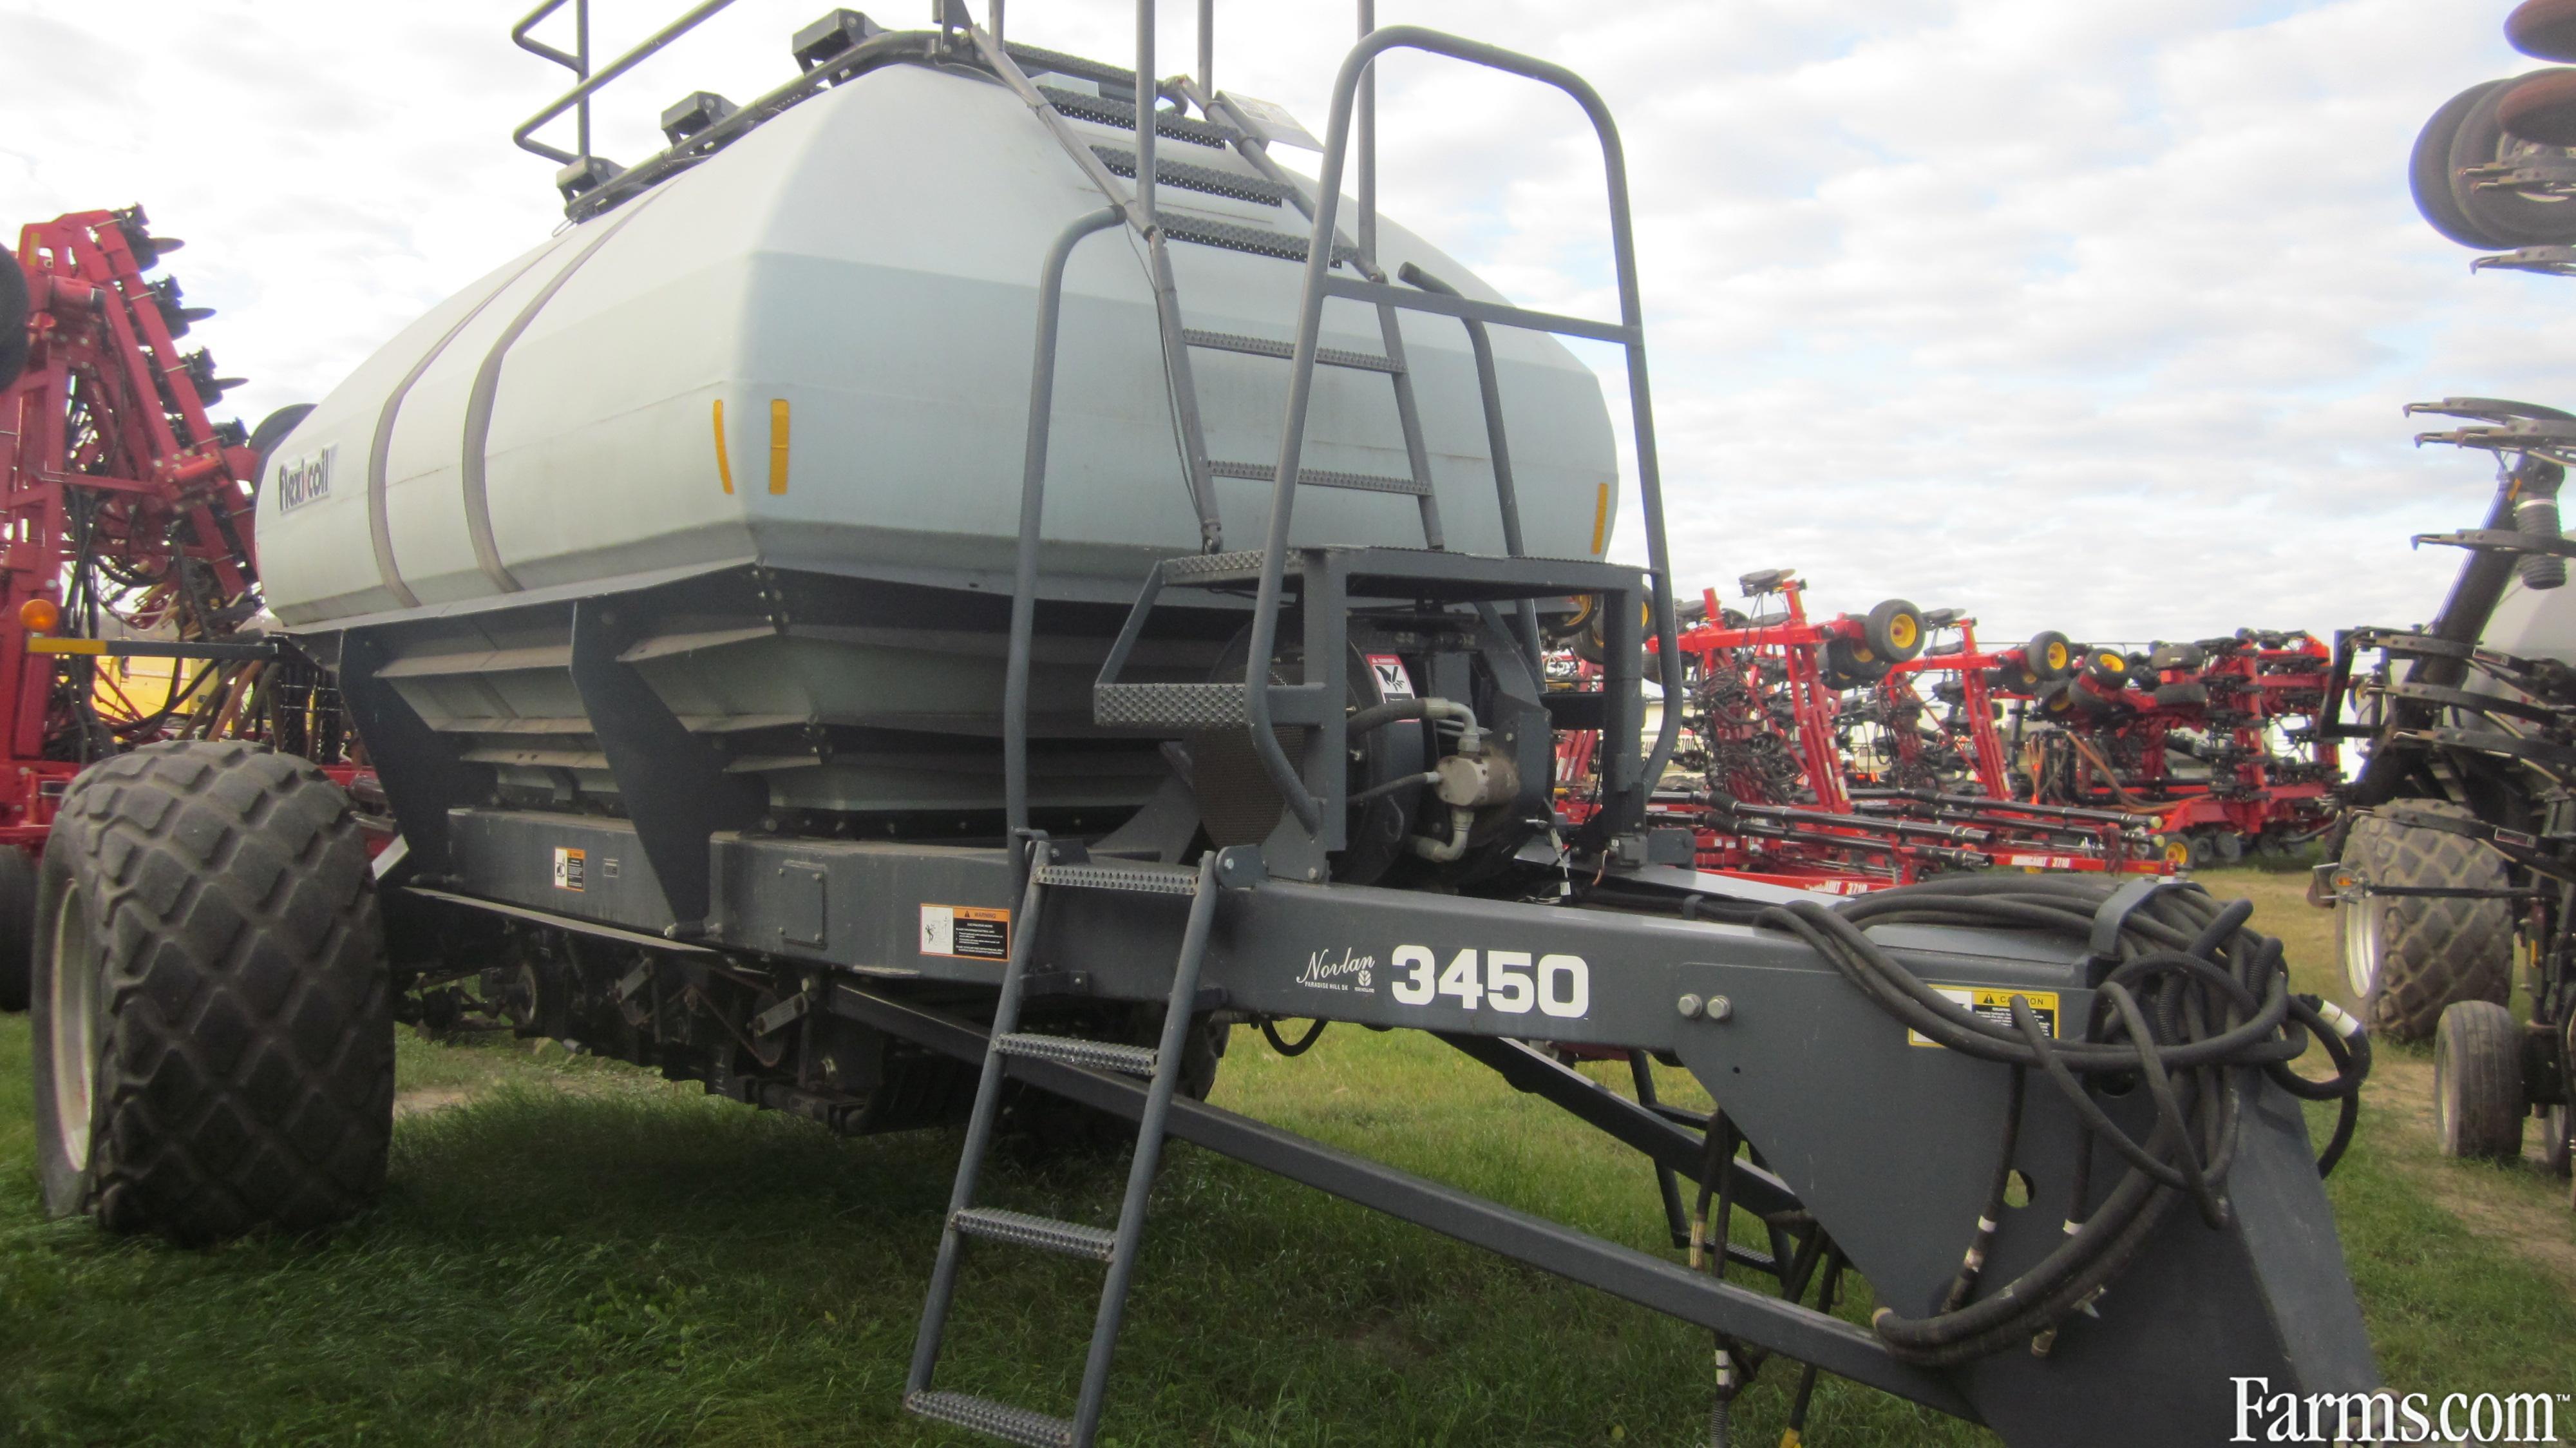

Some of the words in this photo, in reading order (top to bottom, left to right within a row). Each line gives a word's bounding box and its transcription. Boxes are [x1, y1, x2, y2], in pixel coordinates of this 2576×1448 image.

[1296, 947, 1376, 983] Norlan
[1392, 944, 1589, 1018] 3450
[1305, 981, 1329, 989] PARADISE
